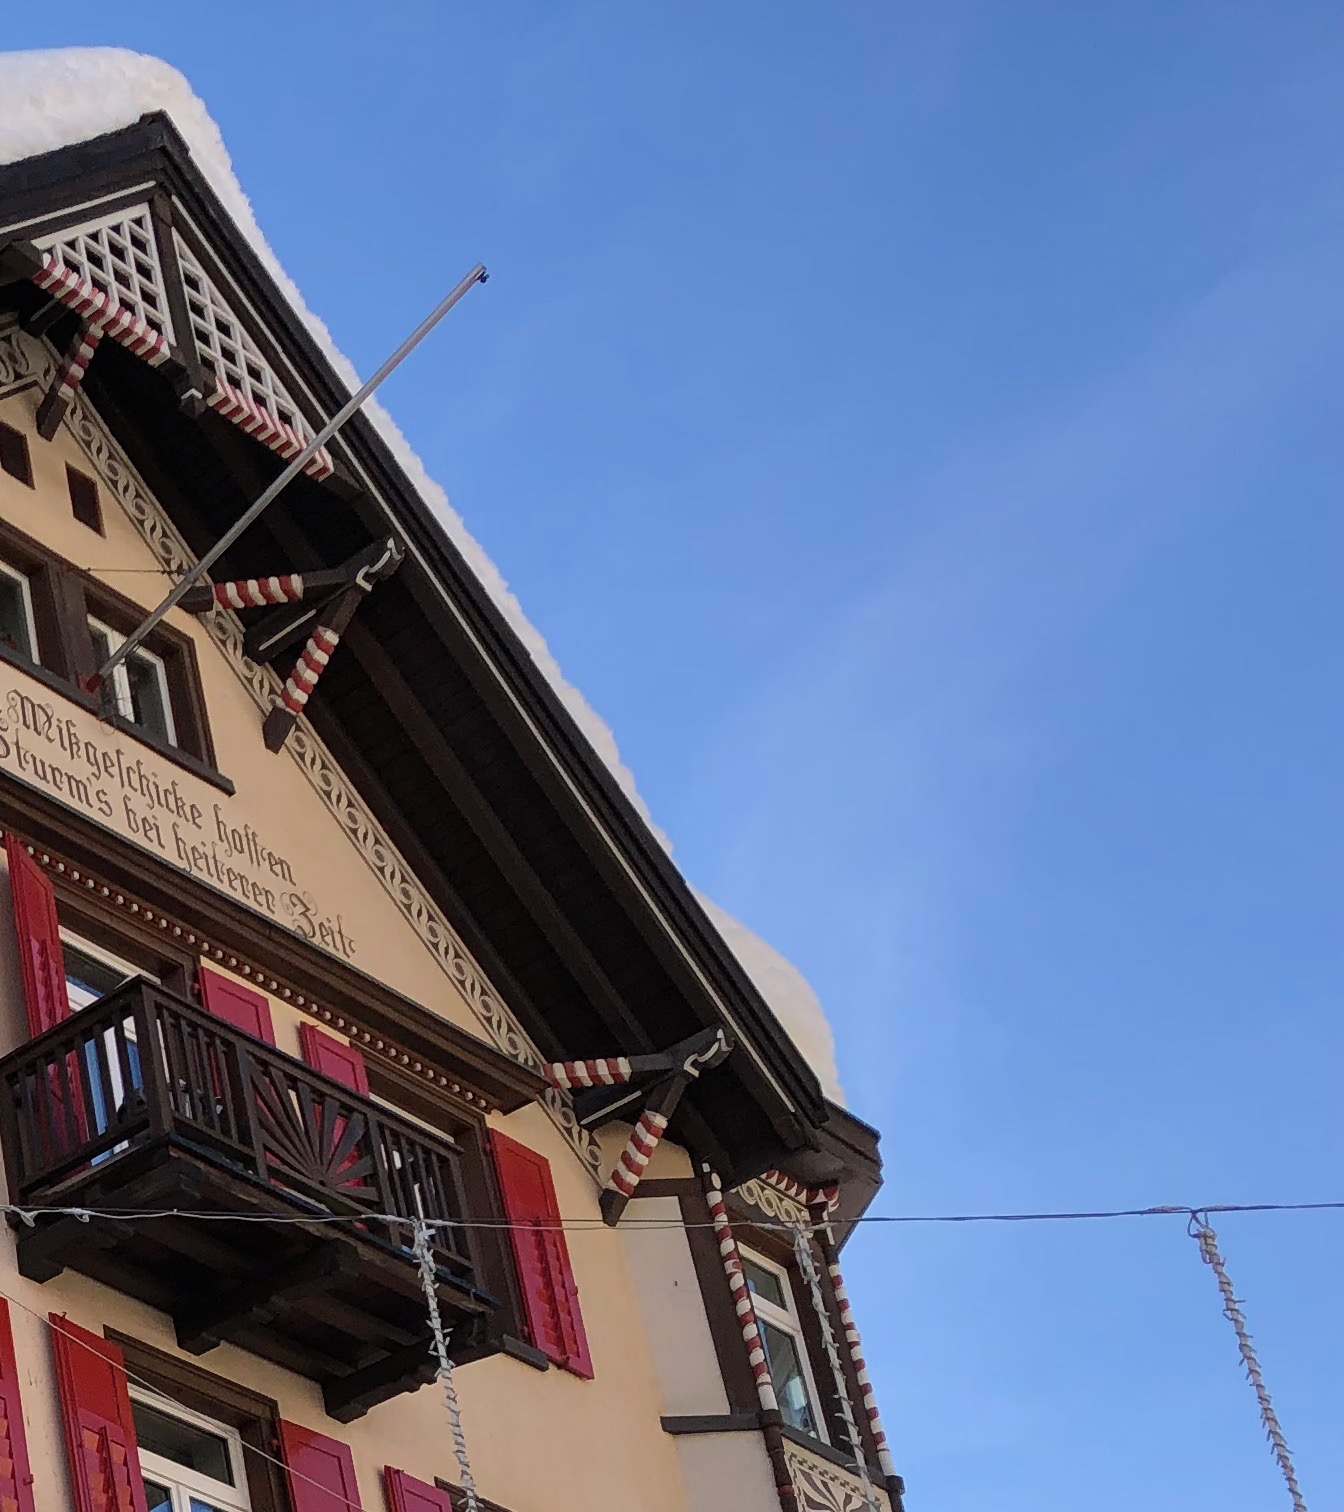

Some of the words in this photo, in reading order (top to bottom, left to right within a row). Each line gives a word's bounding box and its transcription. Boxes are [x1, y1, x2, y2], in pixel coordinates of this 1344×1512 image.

[122, 793, 165, 851] bei
[171, 821, 277, 915] heiterer
[280, 890, 356, 958] Zeit
[213, 803, 297, 888] hoffen
